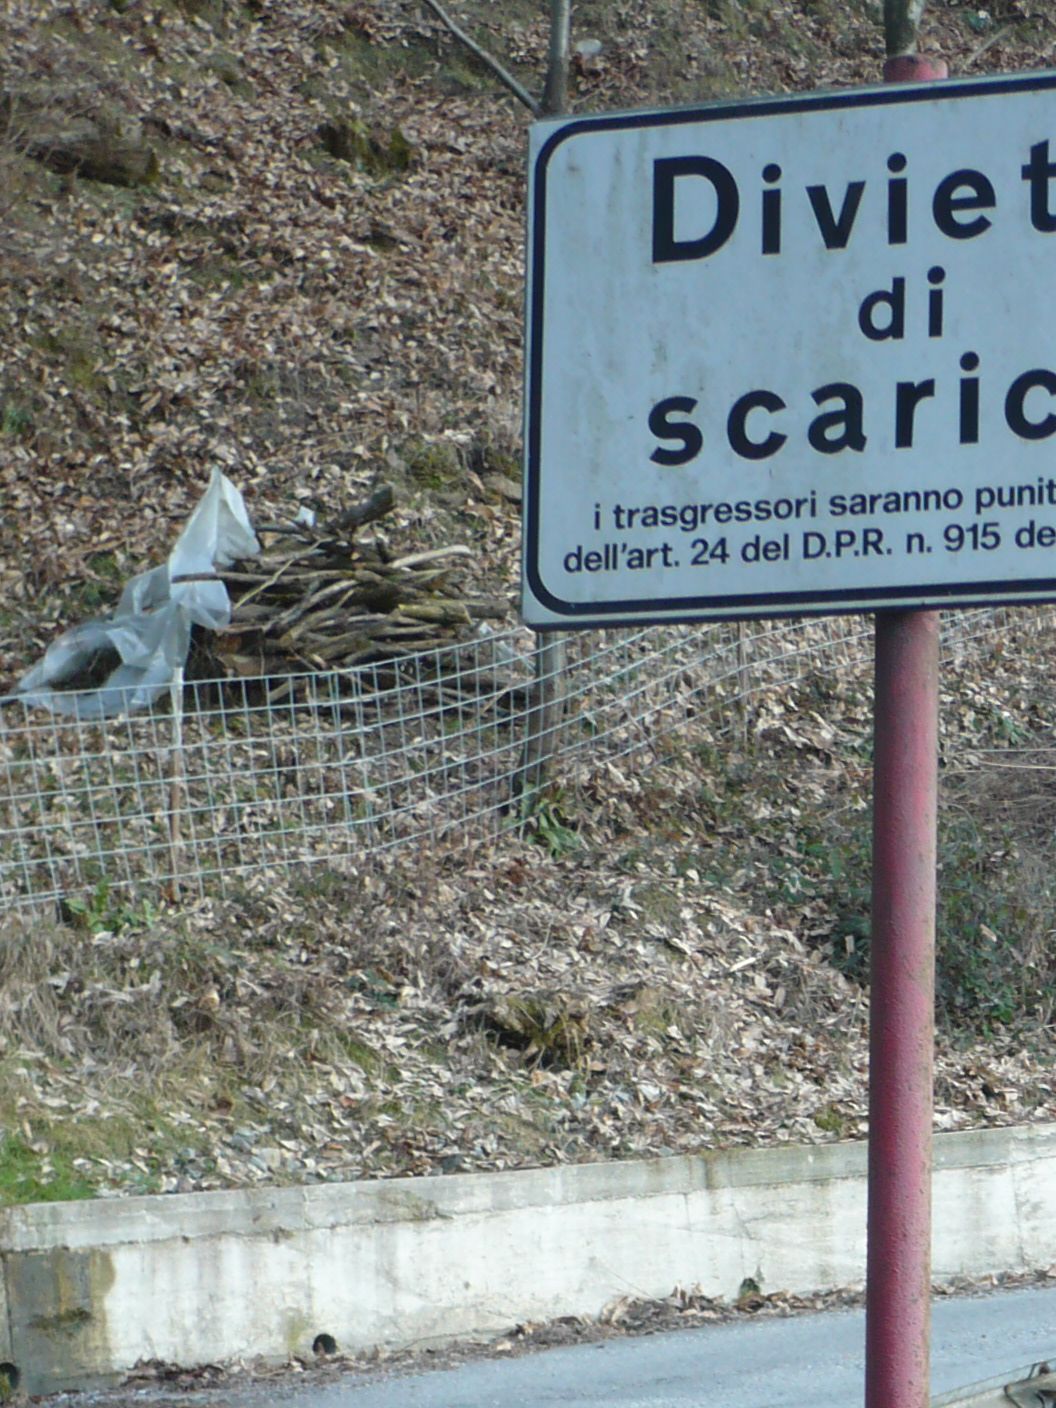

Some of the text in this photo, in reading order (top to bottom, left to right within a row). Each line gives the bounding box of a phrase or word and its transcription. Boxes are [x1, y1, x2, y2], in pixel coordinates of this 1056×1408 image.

[858, 265, 946, 341] di
[594, 502, 601, 531] i
[612, 490, 817, 532] trasgressori
[829, 488, 964, 517] saranno
[563, 542, 681, 573] dell'art.
[691, 537, 730, 566] 24
[741, 533, 790, 563] del
[803, 528, 892, 559] D.P.R.
[906, 532, 932, 554] n.
[943, 522, 1001, 552] 915
